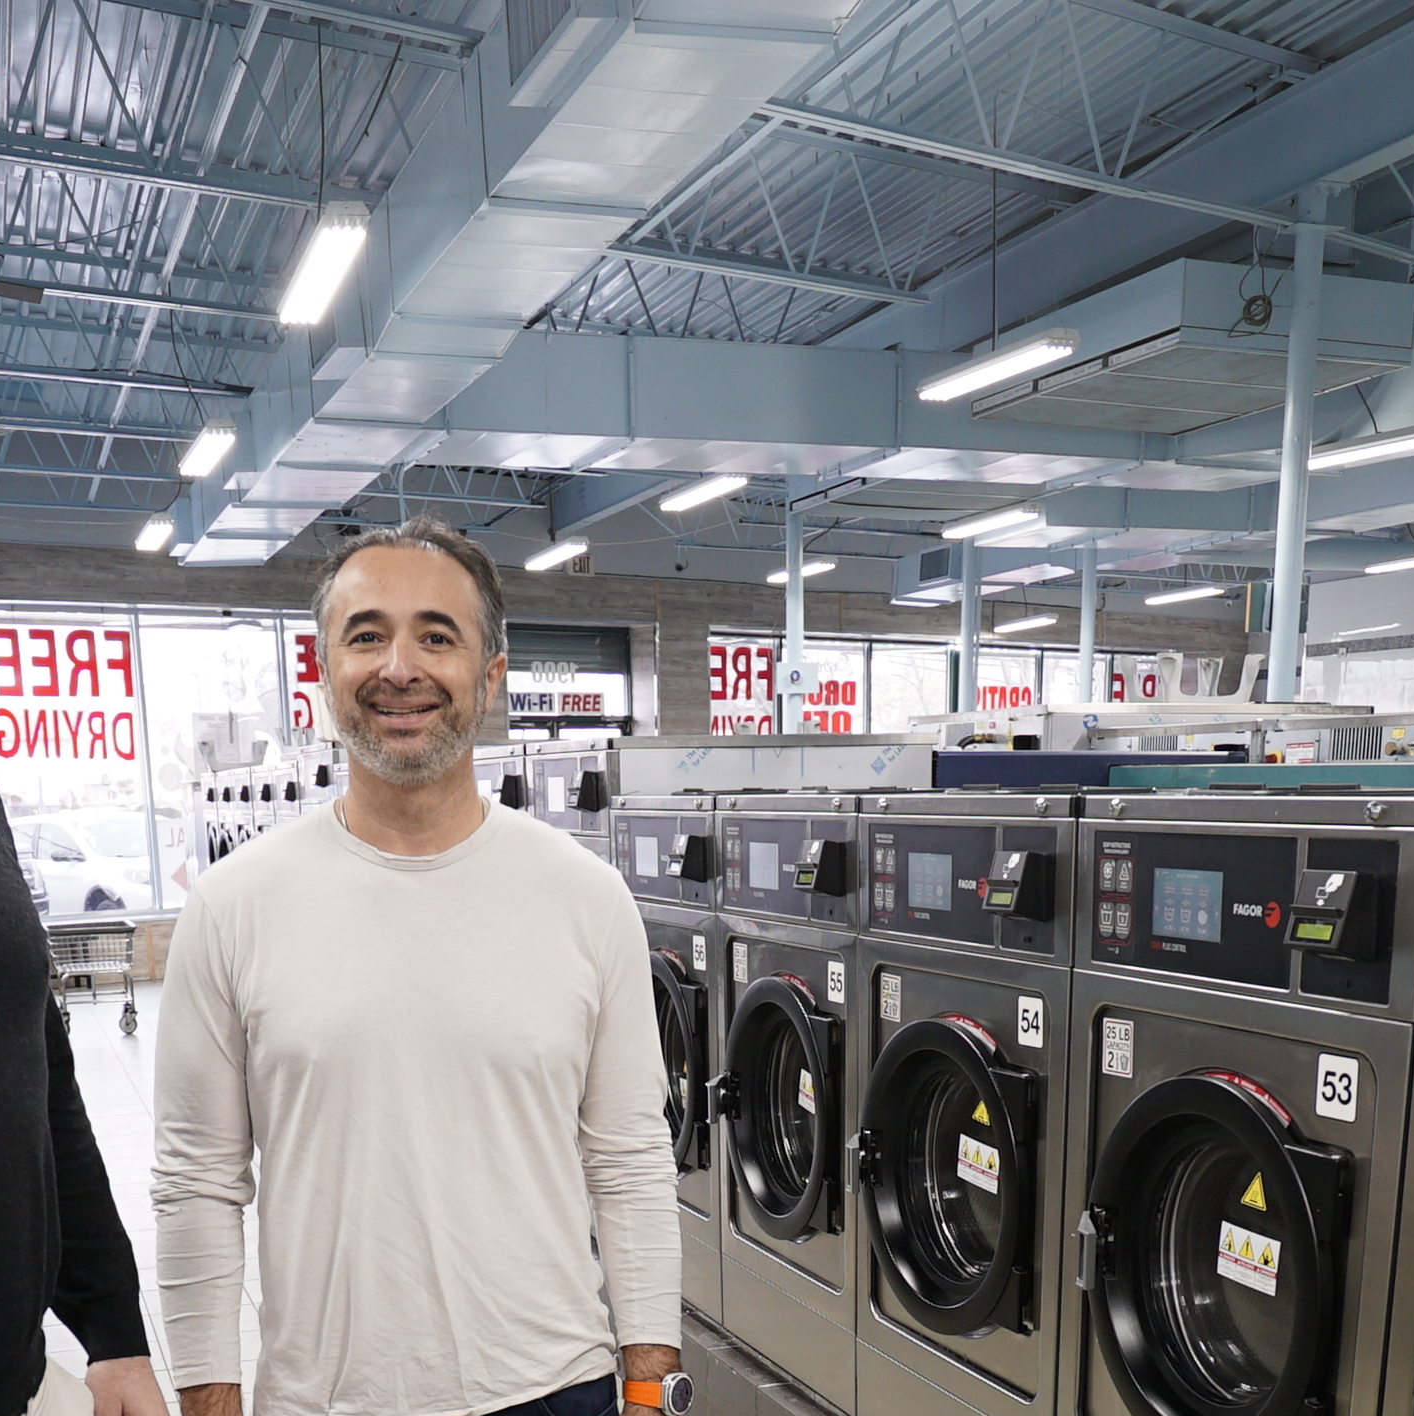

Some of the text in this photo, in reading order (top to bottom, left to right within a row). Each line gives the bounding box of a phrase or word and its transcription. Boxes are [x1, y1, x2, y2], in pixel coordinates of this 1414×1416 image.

[572, 556, 591, 574] EXIT
[510, 693, 601, 712] Wi-Fi FREE
[1233, 903, 1263, 918] FAGOR
[829, 971, 843, 993] 55
[1020, 1008, 1041, 1035] 54
[1106, 1026, 1130, 1041] 25 LB
[1321, 1071, 1353, 1105] 53
